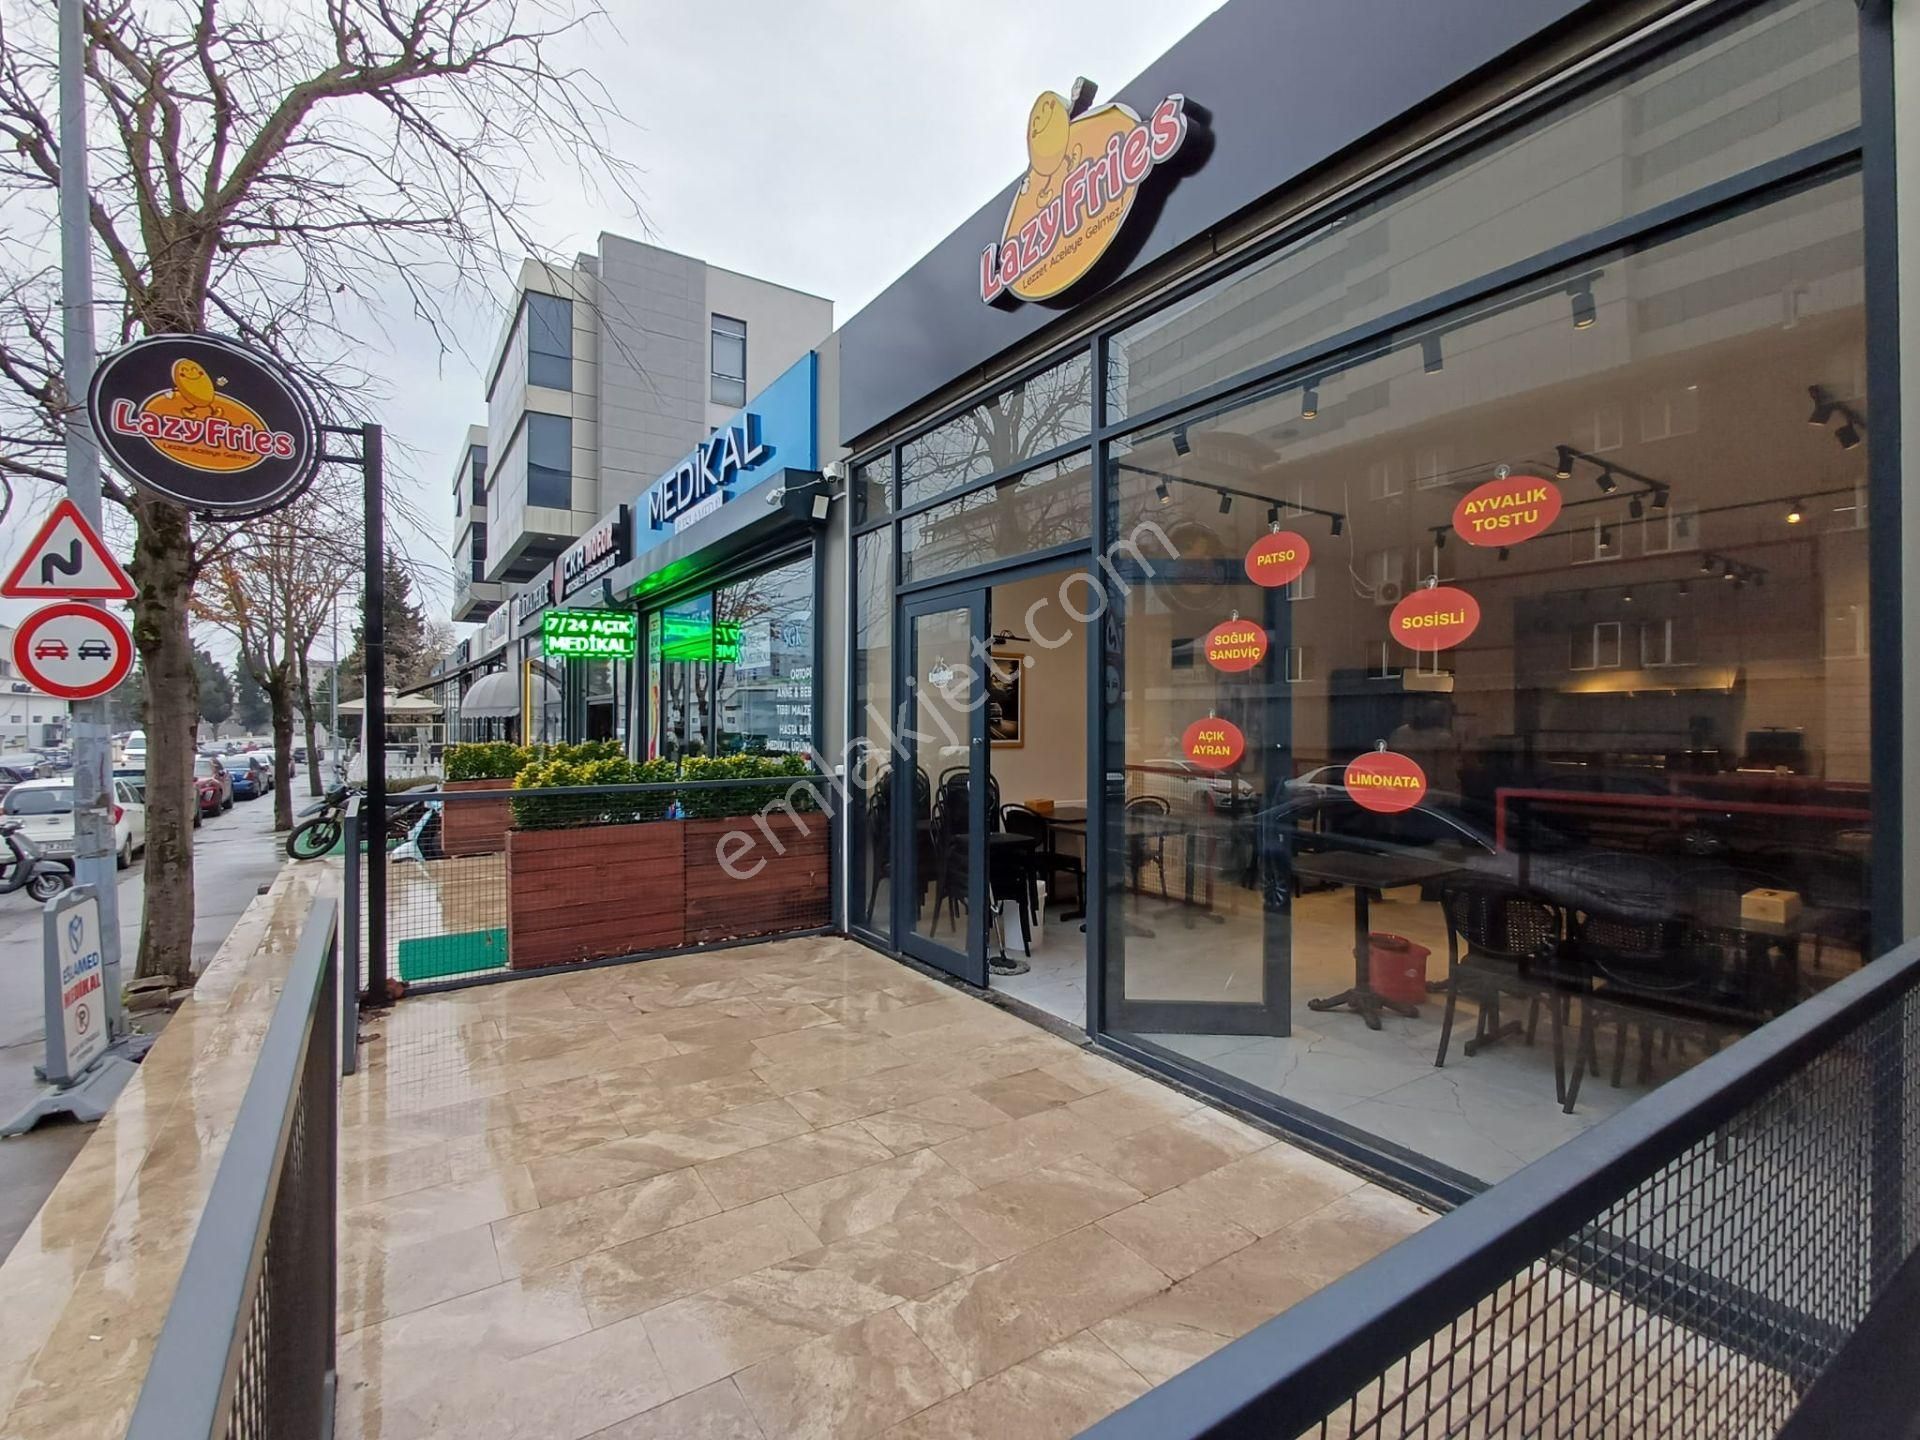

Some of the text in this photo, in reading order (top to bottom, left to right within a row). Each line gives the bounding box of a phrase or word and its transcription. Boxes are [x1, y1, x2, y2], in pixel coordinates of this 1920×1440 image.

[981, 97, 1182, 302] LazyFries
[1022, 264, 1048, 289] Lezzet
[1050, 236, 1083, 269] Aceleye
[113, 399, 294, 458] LazyFries
[649, 412, 763, 529] MEDİKAL
[1464, 487, 1548, 515] AYVALIK
[1472, 509, 1538, 532] TOSTU
[564, 544, 585, 580] CKR
[1257, 549, 1295, 566] PATSO
[548, 617, 631, 635] 7/24 AÇIK
[1402, 608, 1465, 629] SOSİSLİ
[548, 633, 630, 652] MEDİKAL
[1214, 631, 1255, 646] SOĞUK
[1209, 645, 1261, 660] SANDVİÇ
[779, 724, 798, 735] HASTA
[1198, 731, 1225, 743] AÇIK
[1192, 745, 1230, 755] AYRAN
[1349, 770, 1420, 788] LİMONATA
